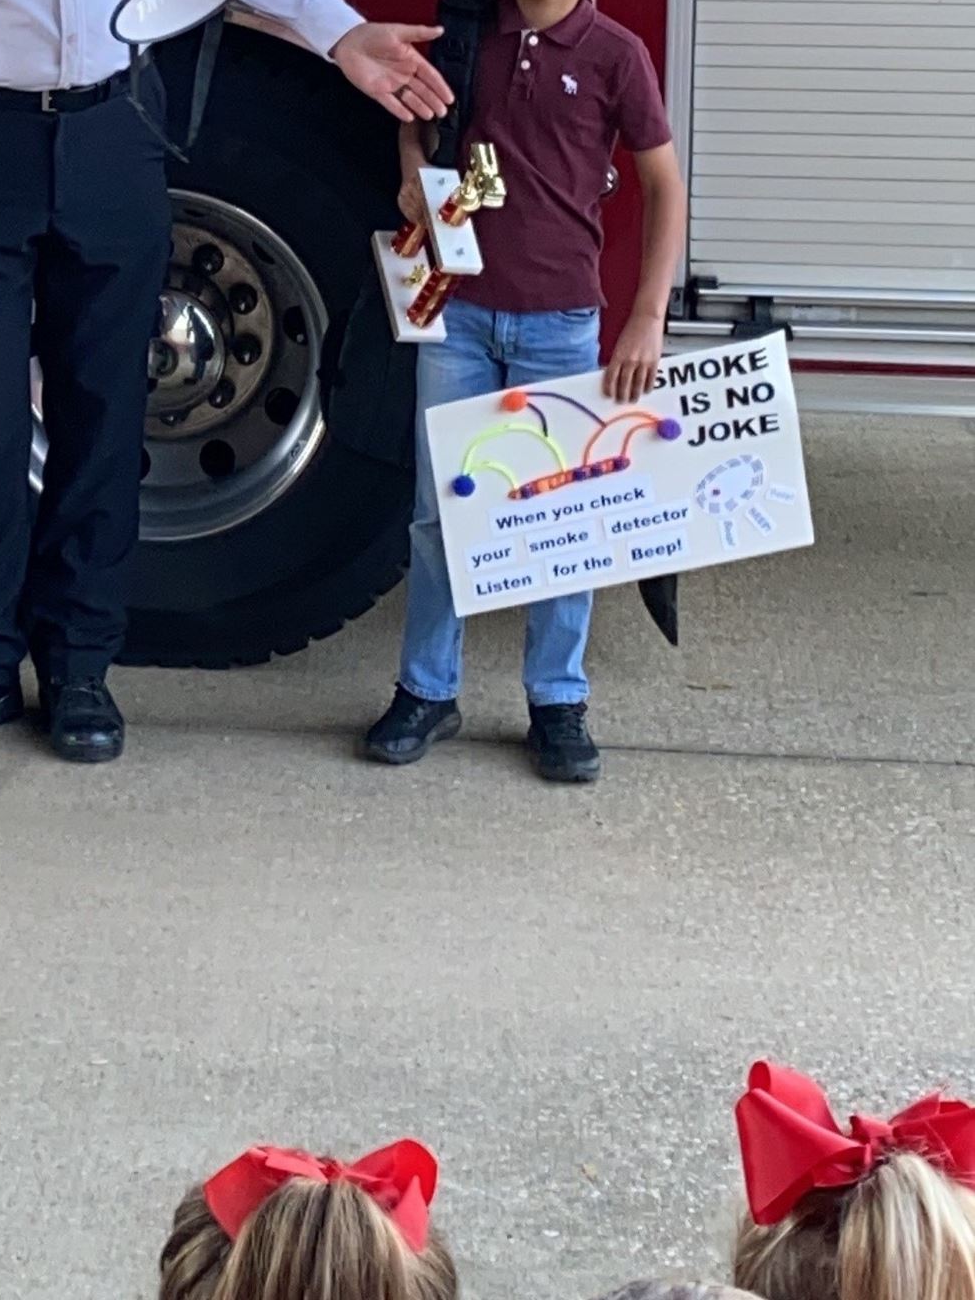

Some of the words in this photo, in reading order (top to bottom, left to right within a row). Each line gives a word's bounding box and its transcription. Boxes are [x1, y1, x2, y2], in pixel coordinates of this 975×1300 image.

[680, 392, 711, 417] IS
[726, 382, 775, 409] NO
[687, 413, 780, 448] JOKE
[496, 511, 546, 530] When
[552, 502, 584, 522] you
[590, 487, 645, 510] check
[471, 547, 512, 569] your
[529, 529, 589, 553] smoke
[611, 506, 689, 534] detector
[476, 573, 532, 596] Listen
[553, 561, 578, 577] for
[583, 555, 613, 571] the
[631, 538, 683, 561] Beep!
